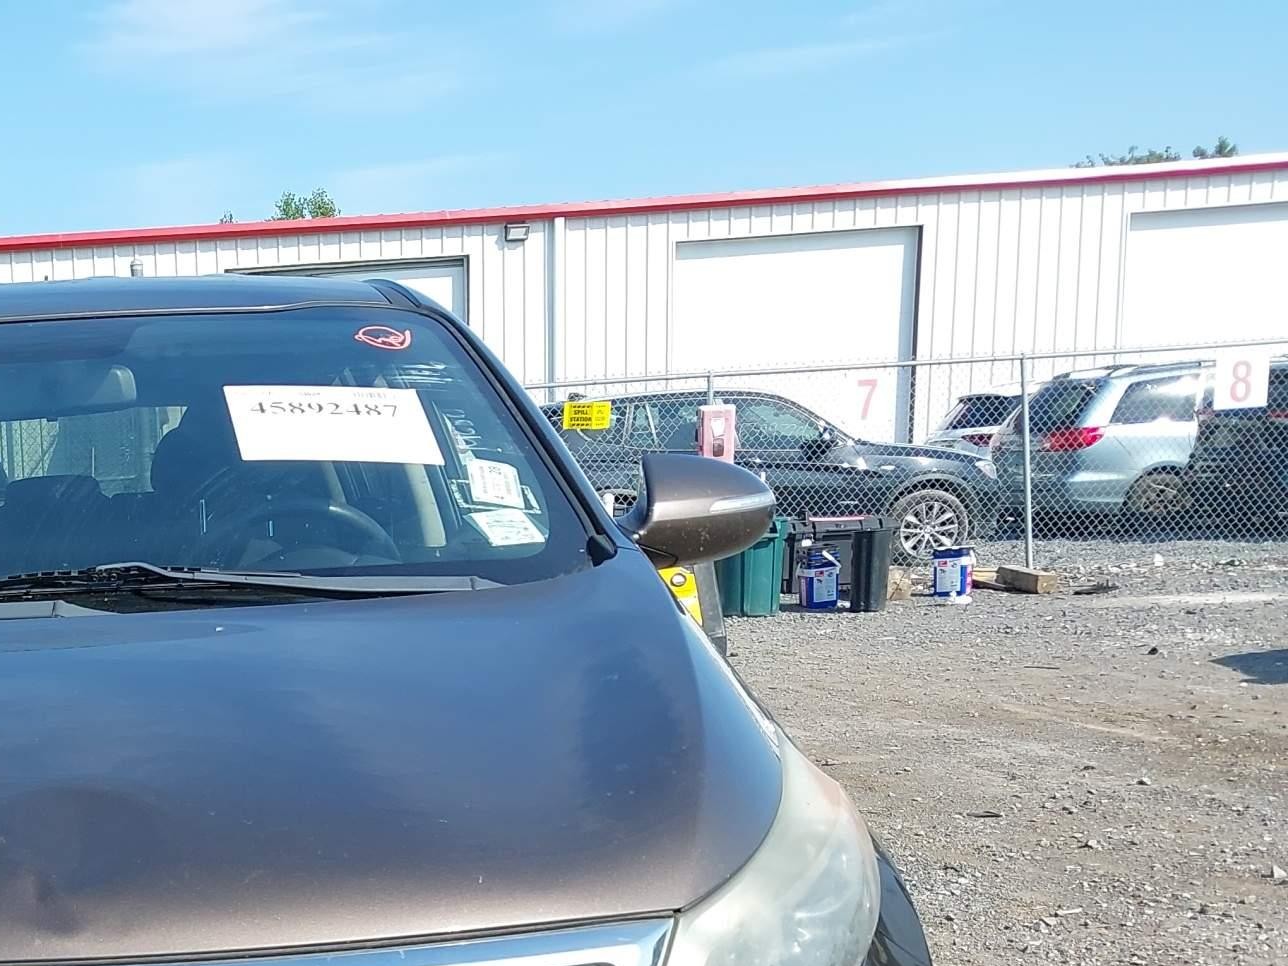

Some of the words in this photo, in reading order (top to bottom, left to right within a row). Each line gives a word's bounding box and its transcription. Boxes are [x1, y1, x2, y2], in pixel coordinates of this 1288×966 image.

[857, 379, 877, 420] 7
[1230, 360, 1252, 402] 8
[250, 401, 398, 417] 45892487
